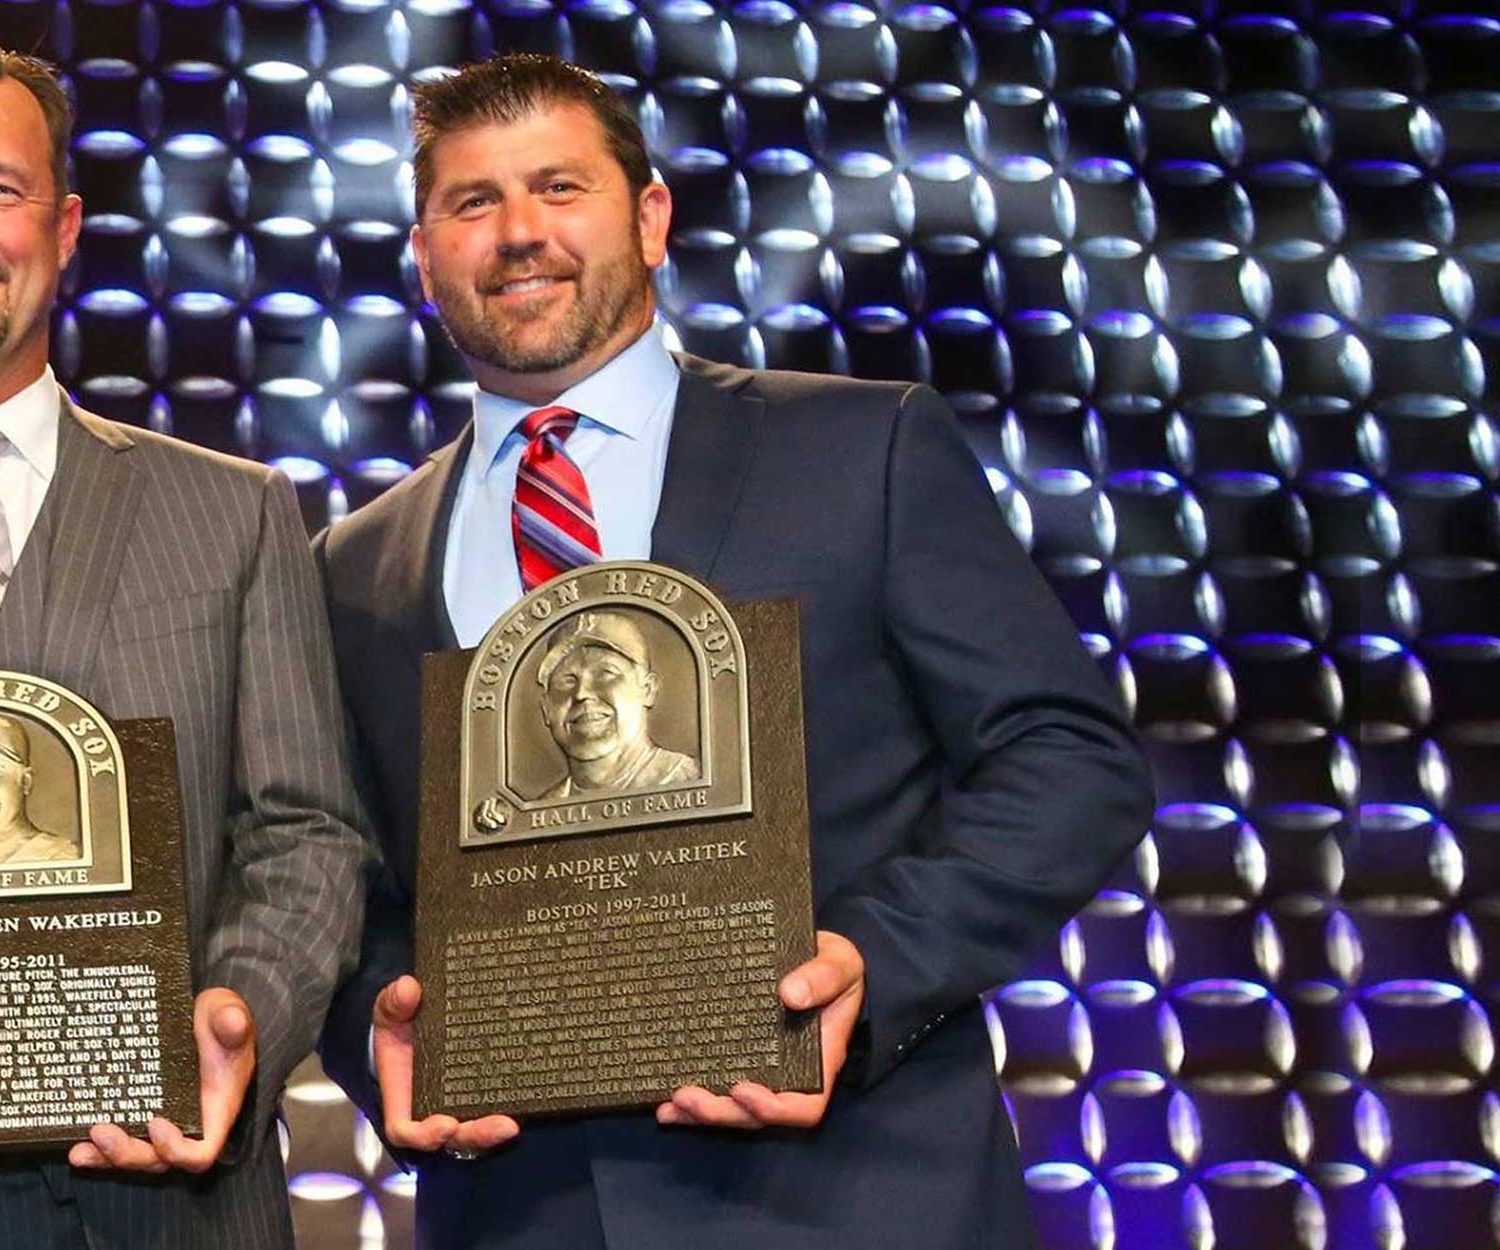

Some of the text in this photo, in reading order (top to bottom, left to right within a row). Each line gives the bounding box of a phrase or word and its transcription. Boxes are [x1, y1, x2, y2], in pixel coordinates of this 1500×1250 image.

[472, 570, 736, 713] BOSTON RED SOX
[69, 718, 115, 777] SOX
[530, 791, 708, 829] HALL OF FAME
[470, 840, 748, 888] JASON ANDREW VARITEK
[24, 868, 89, 886] FAME
[526, 893, 687, 924] BOSTON 1997-2011
[28, 911, 162, 931] WAKEFIELD
[728, 915, 751, 927] WITH
[756, 912, 774, 924] THE
[60, 968, 78, 977] THE
[10, 982, 30, 992] RED
[59, 978, 115, 989] ORIGINALLY
[119, 976, 156, 986] SIGNED
[14, 994, 24, 1004] IN
[64, 989, 122, 1001] WAKEFIELD
[127, 988, 156, 998] WENT
[88, 1000, 156, 1012] SPECTACULAR
[4, 1017, 62, 1028] ULTIMATELY
[67, 1014, 116, 1025] RESULTED
[122, 1013, 132, 1022] IN
[26, 1029, 60, 1039] ROGER
[66, 1027, 113, 1037] CLEMENS
[118, 1025, 139, 1035] AND
[146, 1025, 158, 1033] CY
[17, 1041, 55, 1052] HELPED
[60, 1040, 78, 1050] THE
[83, 1039, 102, 1049] SOX
[107, 1038, 119, 1048] TO
[124, 1037, 159, 1047] WORLD
[17, 1055, 29, 1065] 45
[34, 1054, 65, 1064] YEARS
[69, 1052, 90, 1062] AND
[94, 1052, 106, 1061] 54
[111, 1050, 136, 1060] DAYS
[140, 1049, 160, 1058] OLD
[0, 1068, 12, 1077] OF
[20, 1067, 36, 1077] HIS
[43, 1065, 83, 1075] CAREER
[89, 1064, 99, 1073] IN
[141, 1061, 160, 1071] THE
